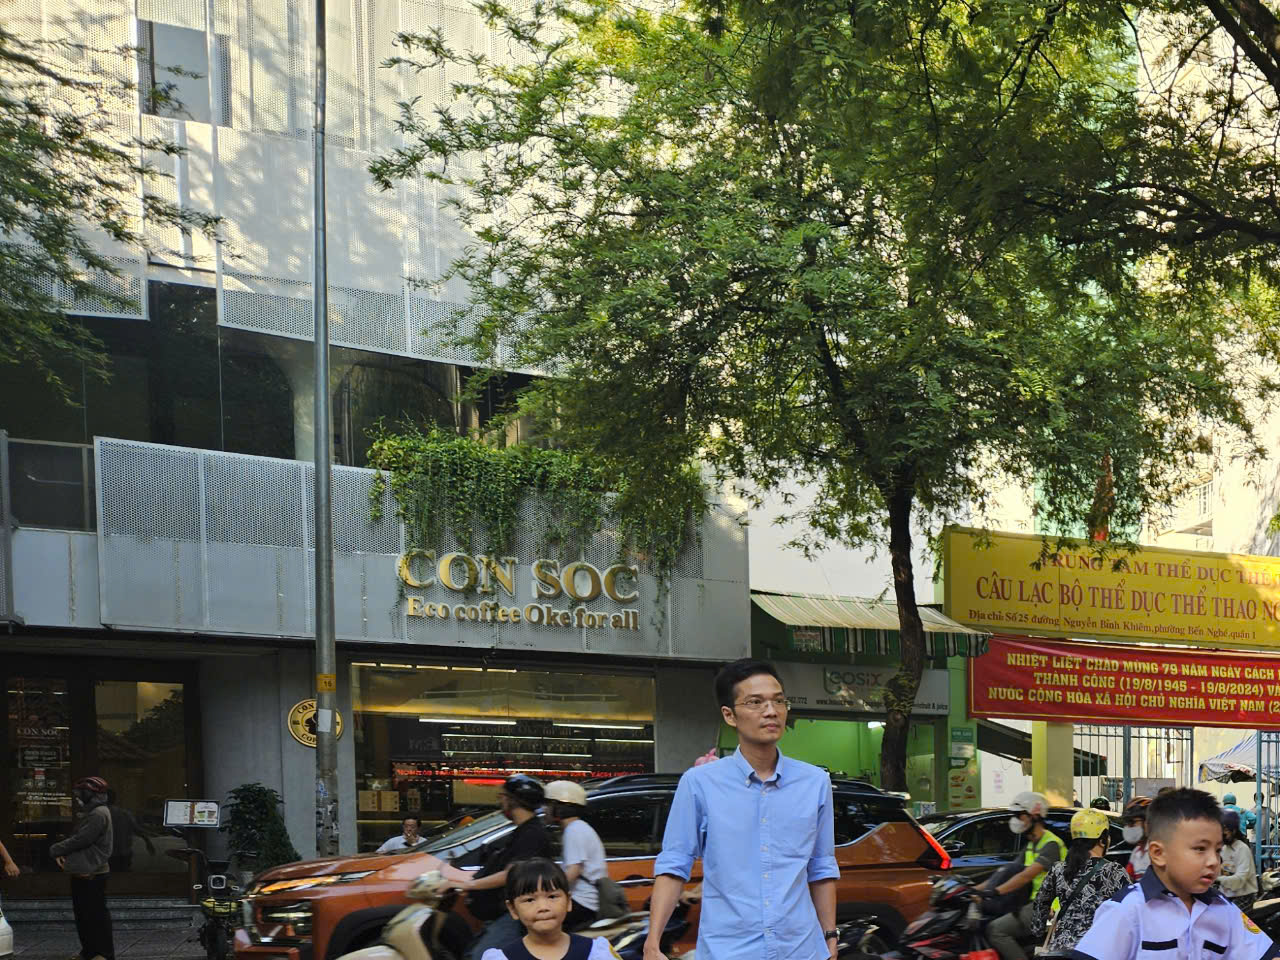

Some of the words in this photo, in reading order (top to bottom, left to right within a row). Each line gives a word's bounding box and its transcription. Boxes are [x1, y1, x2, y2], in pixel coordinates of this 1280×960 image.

[397, 549, 519, 597] CON
[532, 559, 640, 602] SOC
[1154, 558, 1192, 579] THỂ
[1196, 567, 1232, 587] DỤC
[976, 571, 1012, 601] CÂU
[1018, 580, 1053, 608] LẠC
[1059, 578, 1083, 611] BỘ
[1088, 579, 1125, 610] THỂ
[1131, 590, 1166, 617] DỤC
[1172, 585, 1207, 616] THỂ
[1212, 595, 1257, 620] THAO
[406, 597, 450, 620] Eco
[454, 600, 521, 624] coffee
[524, 603, 571, 627] Oke
[574, 606, 608, 629] for
[611, 609, 640, 631] all
[968, 609, 985, 622] Địa
[1019, 613, 1029, 623] 25
[1063, 616, 1097, 629] Nguyễn
[1007, 652, 1048, 669] NHIỆT
[1053, 654, 1082, 671] LIỆT
[1086, 655, 1119, 672] CHÀO
[1162, 664, 1178, 676] 79
[1182, 662, 1207, 677] NĂM
[1211, 663, 1241, 679] NGÀY
[1244, 664, 1274, 680] CÁCH
[1034, 670, 1078, 687] THÀNH
[1082, 673, 1115, 689] CÔNG
[1119, 676, 1187, 693] (19/8/1945
[1201, 681, 1264, 698] 19/8/2024)
[1028, 687, 1062, 704] CỘNG
[1066, 689, 1092, 705] HÒA
[1115, 692, 1136, 709] HỘI
[1140, 691, 1165, 709] CHỦ
[1169, 696, 1205, 710] NGHĨA
[1209, 697, 1237, 713] VIỆT
[1240, 699, 1265, 712] NAM
